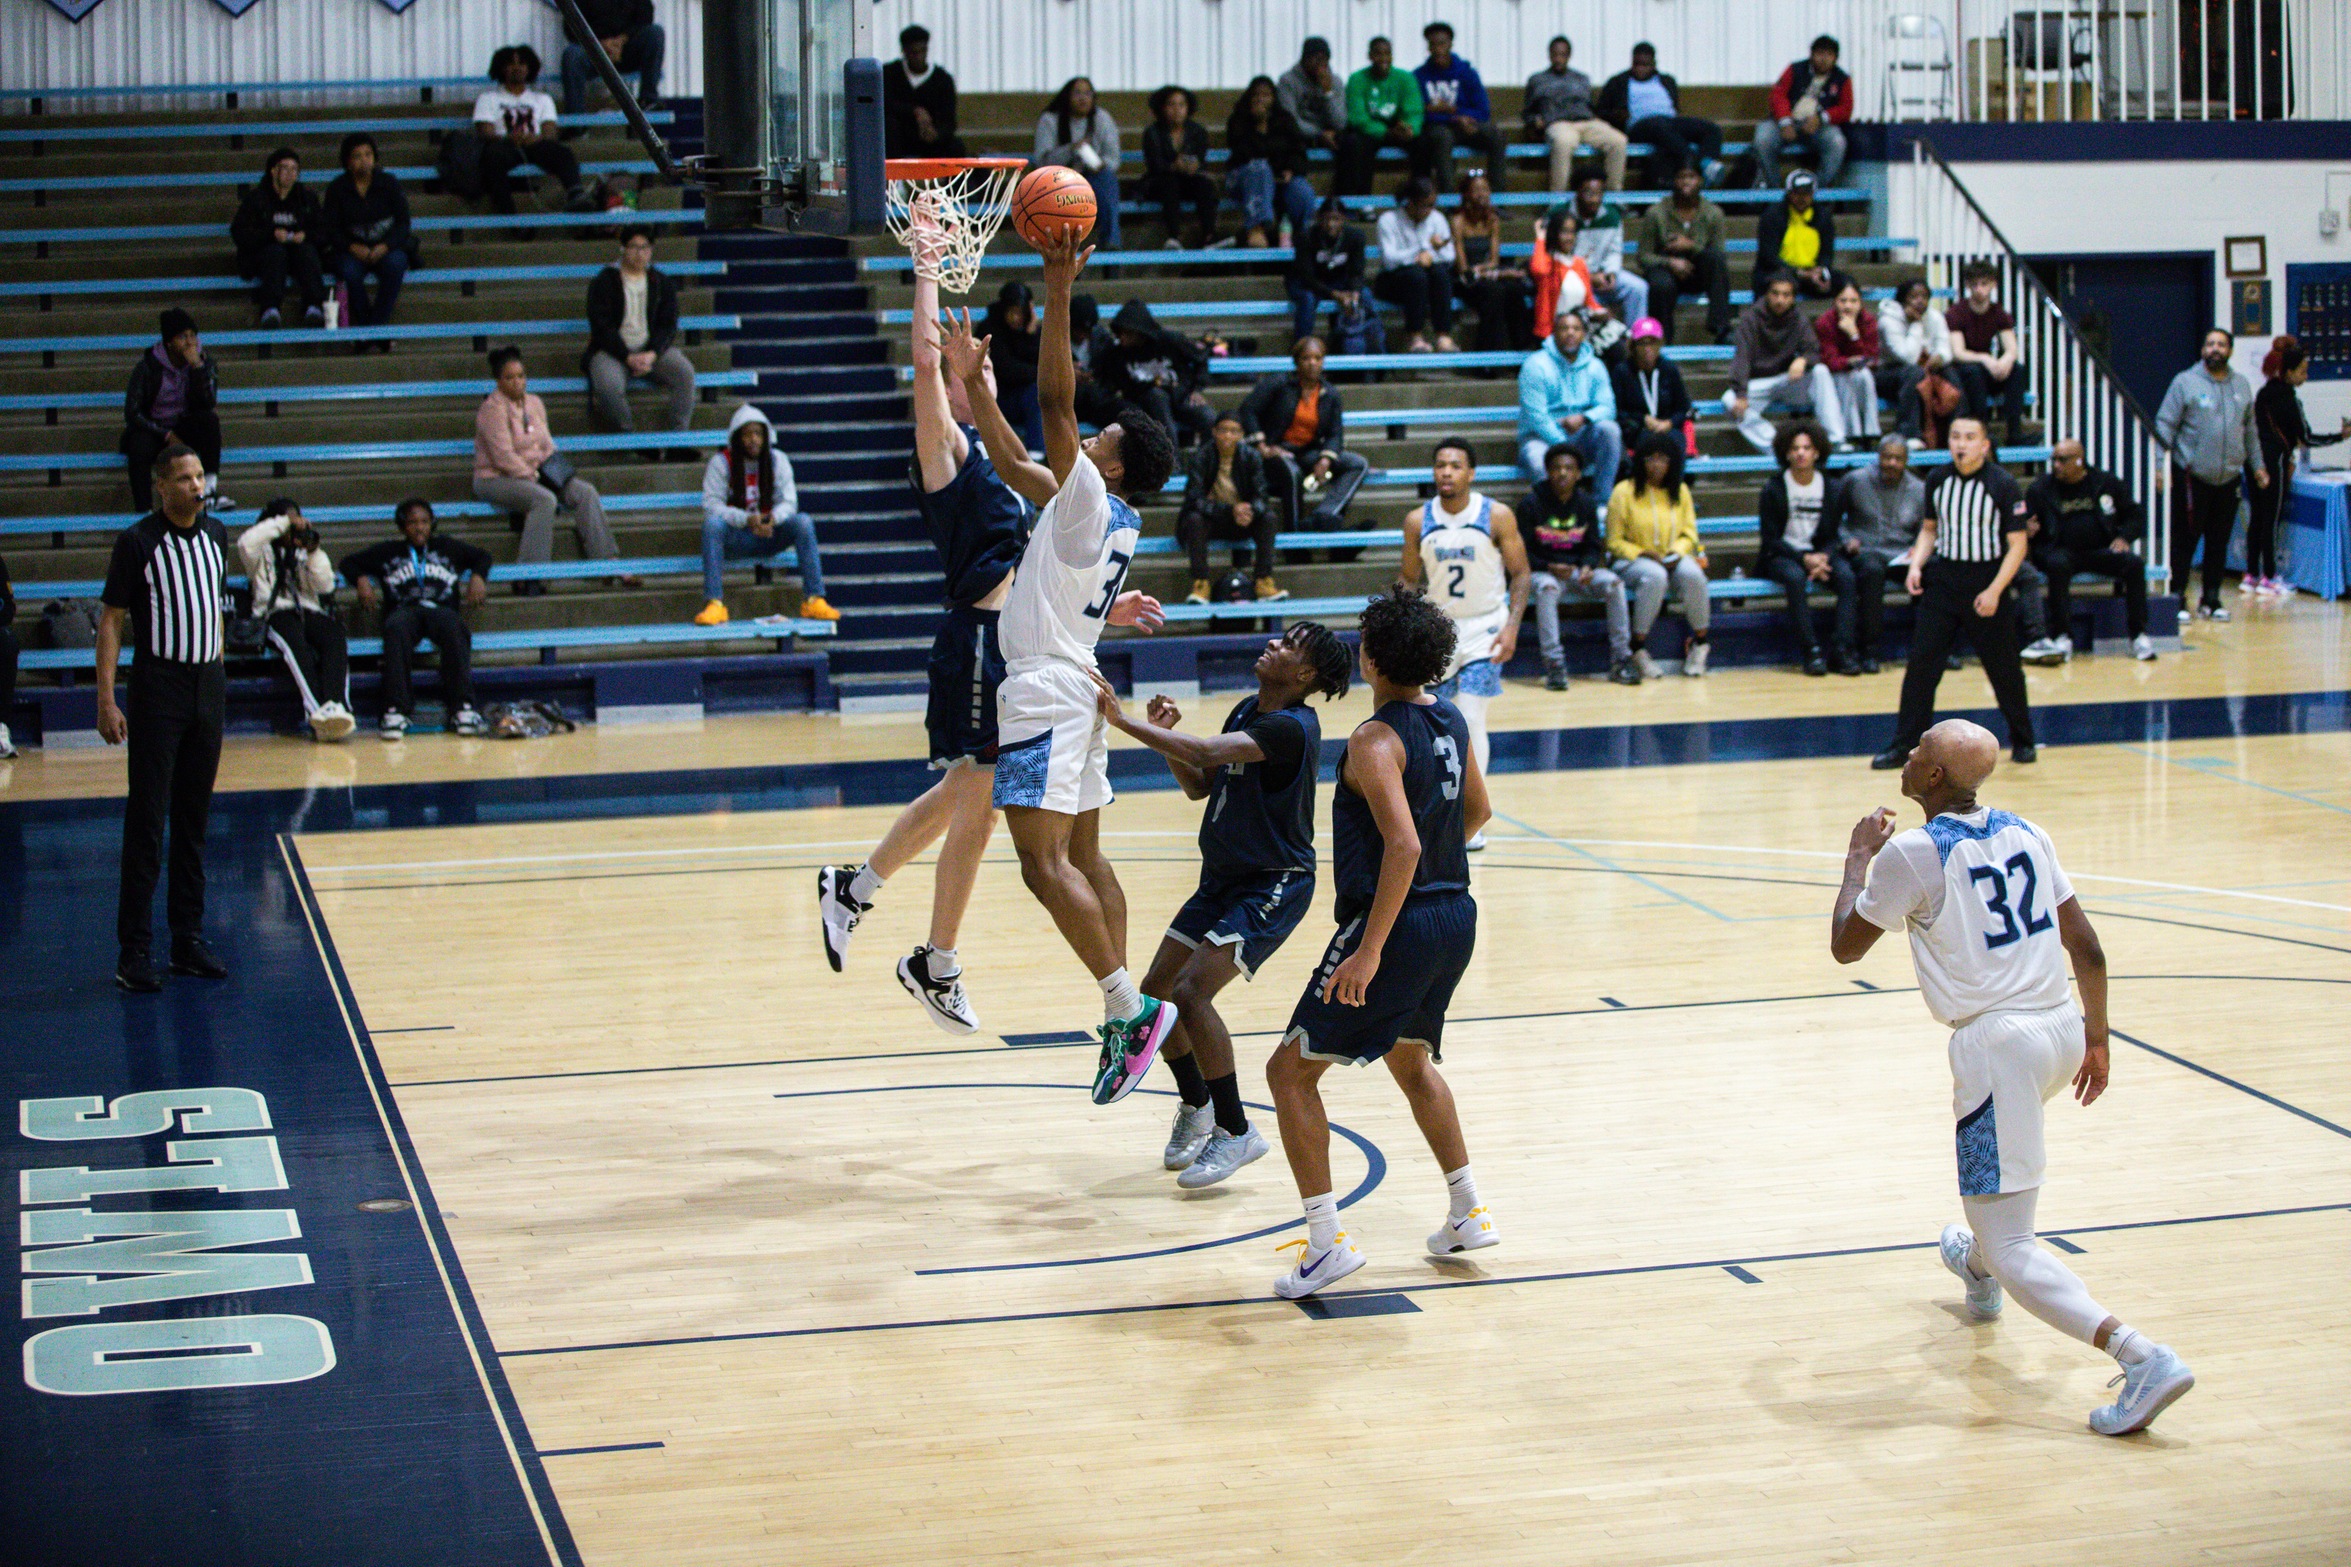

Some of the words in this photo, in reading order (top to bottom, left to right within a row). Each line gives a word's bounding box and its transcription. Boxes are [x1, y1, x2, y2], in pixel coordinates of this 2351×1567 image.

[1448, 565, 1465, 598] 2
[1432, 734, 1462, 800] 3
[1968, 850, 2055, 951] 32
[20, 1087, 337, 1396] OWLS
